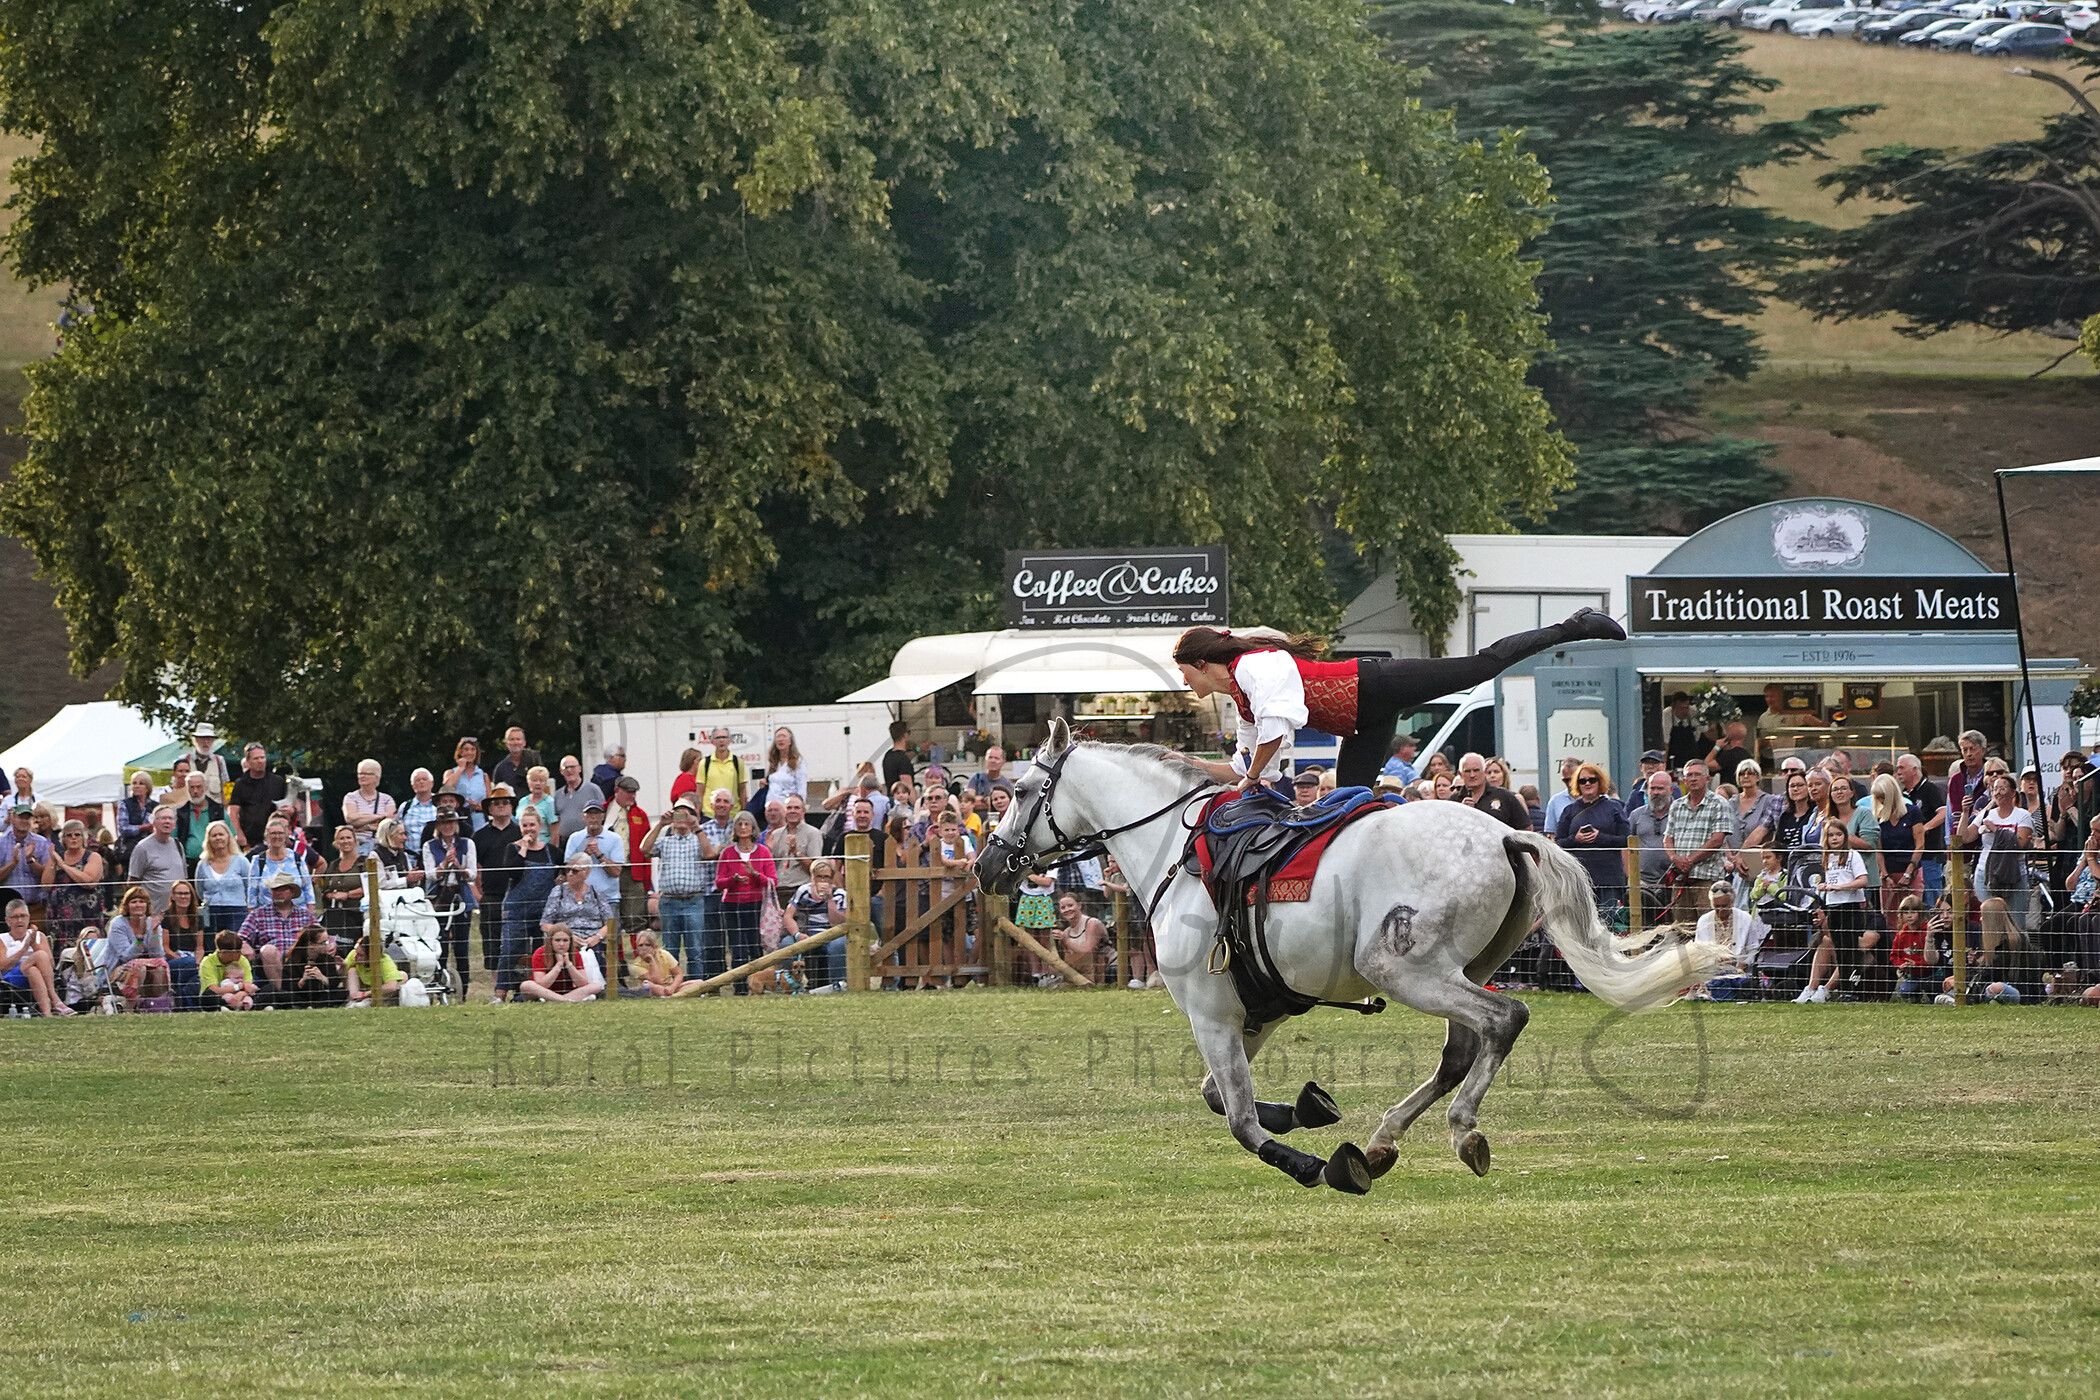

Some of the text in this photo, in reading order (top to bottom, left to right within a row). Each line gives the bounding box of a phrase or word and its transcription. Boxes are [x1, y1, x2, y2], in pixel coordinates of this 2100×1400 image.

[1013, 569, 1098, 606] Coffee
[1141, 566, 1219, 596] Cakes
[1645, 588, 2000, 621] Traditional Roast Meats
[1070, 613, 1112, 624] Chocolate
[1151, 612, 1179, 624] Coffee
[1190, 611, 1217, 622] Cakes
[1834, 650, 1856, 662] 1976
[1563, 733, 1595, 748] Pork
[2026, 759, 2061, 773] ead
